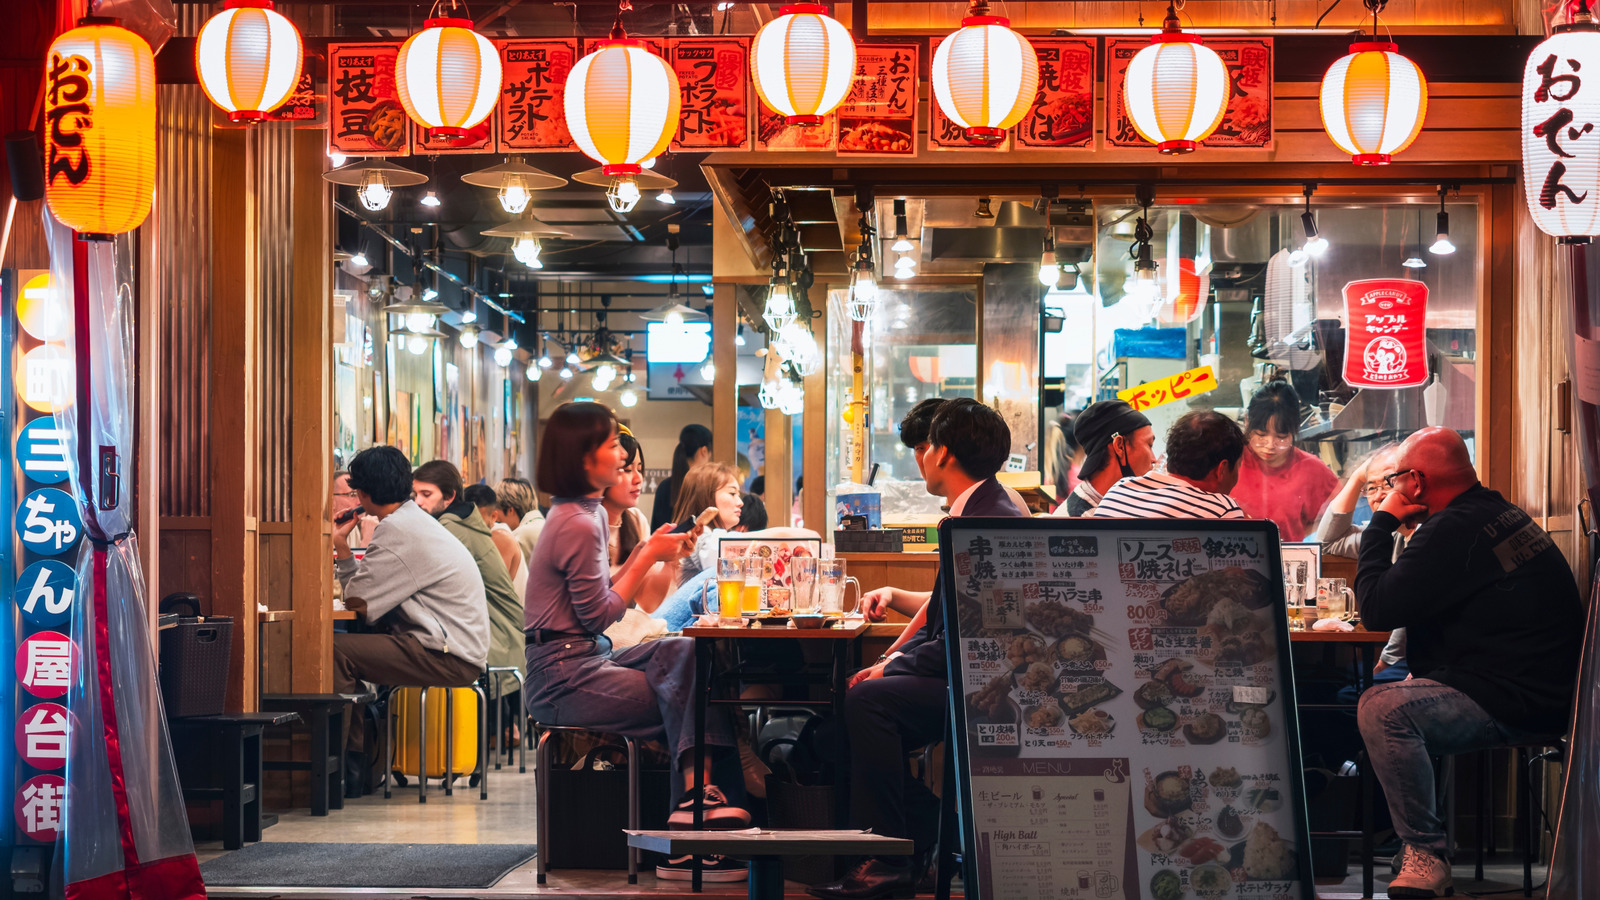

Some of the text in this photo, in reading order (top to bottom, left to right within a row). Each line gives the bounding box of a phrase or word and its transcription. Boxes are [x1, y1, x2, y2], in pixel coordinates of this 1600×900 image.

[339, 58, 374, 66] とりあえず
[508, 51, 546, 61] とりあえず
[678, 50, 714, 58] サックサク
[1060, 49, 1090, 93] 鉄板
[1241, 47, 1267, 87] 鉄板
[887, 51, 911, 110] おでん
[334, 69, 377, 138] 枝豆
[504, 61, 553, 141] ポテト サラダ
[680, 61, 718, 141] フライド ポテト
[48, 54, 93, 187] おでん
[1533, 54, 1594, 211] おでん
[1365, 314, 1407, 324] アップル
[1366, 324, 1408, 334] キャンデー
[1127, 372, 1209, 412] ホッピー
[1123, 541, 1175, 562] ソース
[1202, 536, 1259, 559] 銀ちゃん
[966, 535, 998, 597] 串焼き
[1137, 557, 1197, 581] 焼そば
[1038, 587, 1102, 604] 牛ハラミ串
[1127, 605, 1168, 619] 800円
[1024, 739, 1046, 747] とり天
[1023, 762, 1072, 774] MENU
[978, 790, 1025, 802] 生ビール
[993, 830, 1039, 842] High Ball
[1235, 882, 1293, 896] ポテトサラダ
